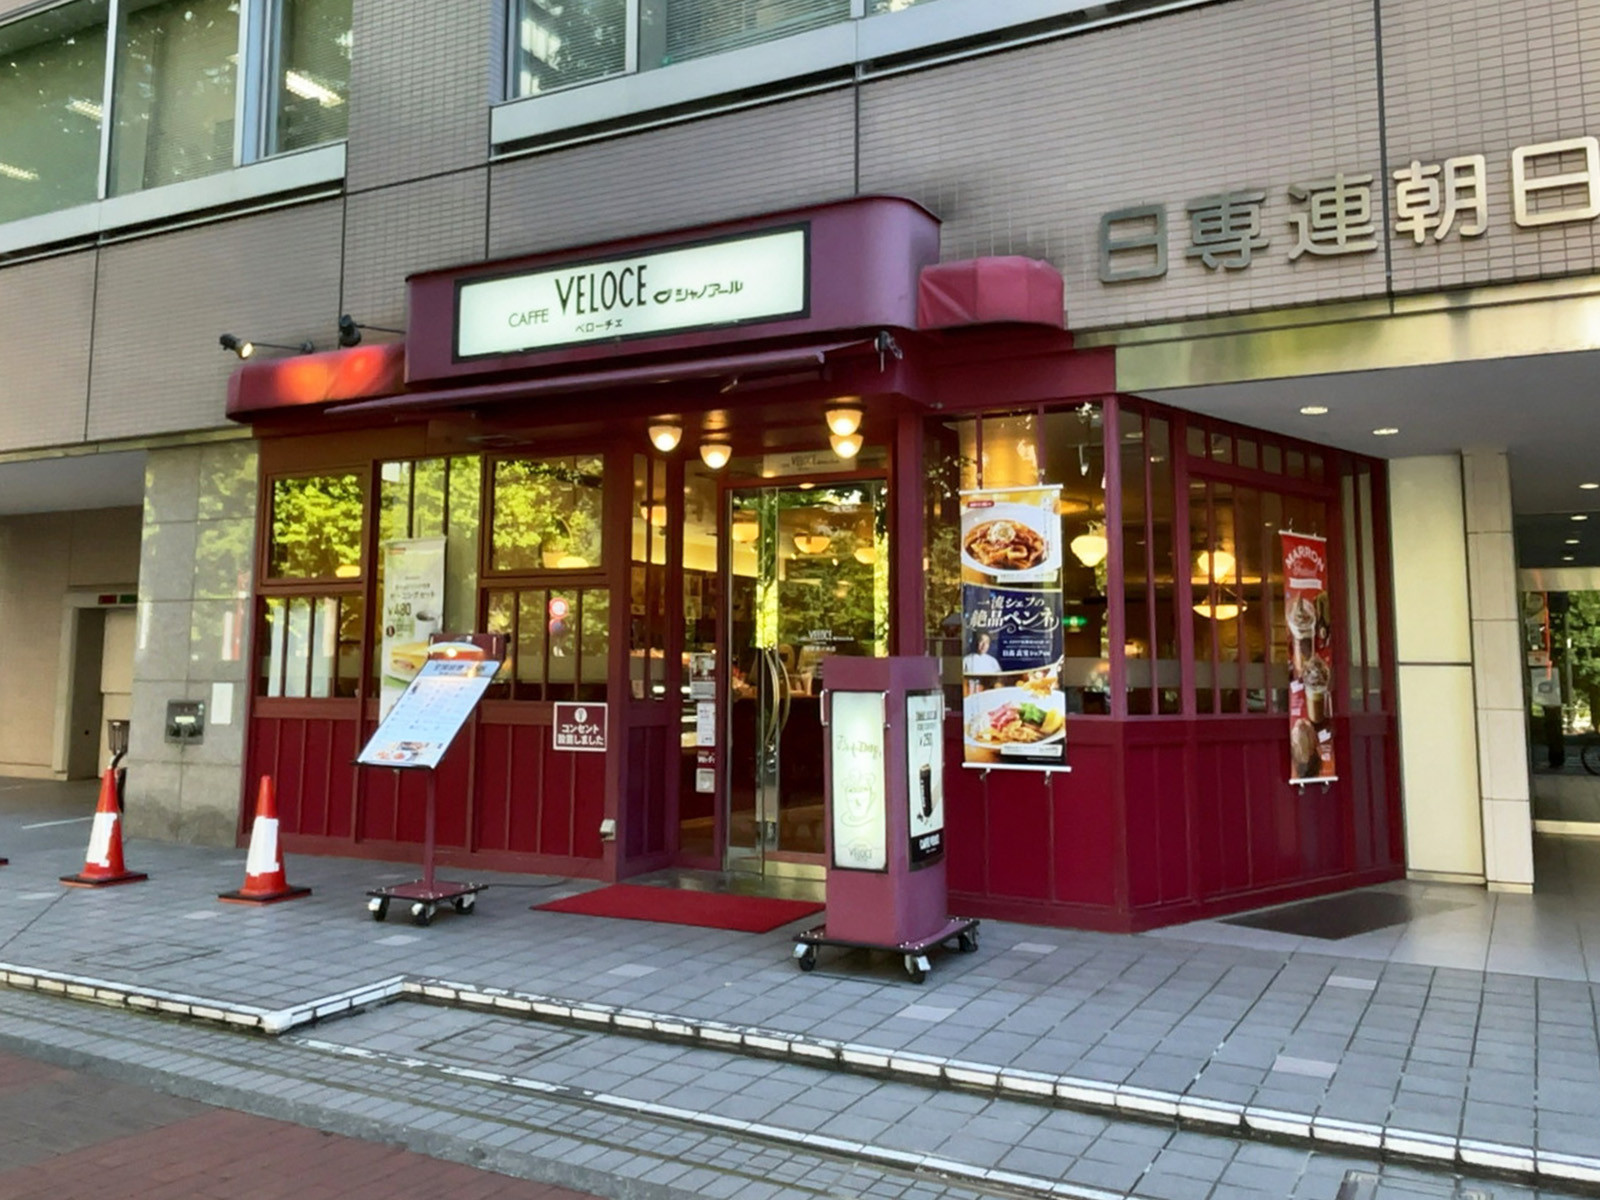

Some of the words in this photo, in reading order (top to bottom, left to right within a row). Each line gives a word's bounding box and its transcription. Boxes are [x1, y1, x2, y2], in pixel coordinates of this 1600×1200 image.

[1100, 135, 1600, 284] 日専連朝日
[508, 308, 549, 328] CAFFE
[555, 264, 648, 315] VELOCE
[675, 281, 743, 303] シャノアール
[575, 318, 622, 333] ベローチェ
[1285, 545, 1325, 572] MARRON
[969, 606, 1055, 628] 絶品ペンネ
[557, 733, 604, 746] 設置しました
[561, 724, 600, 735] コンセント
